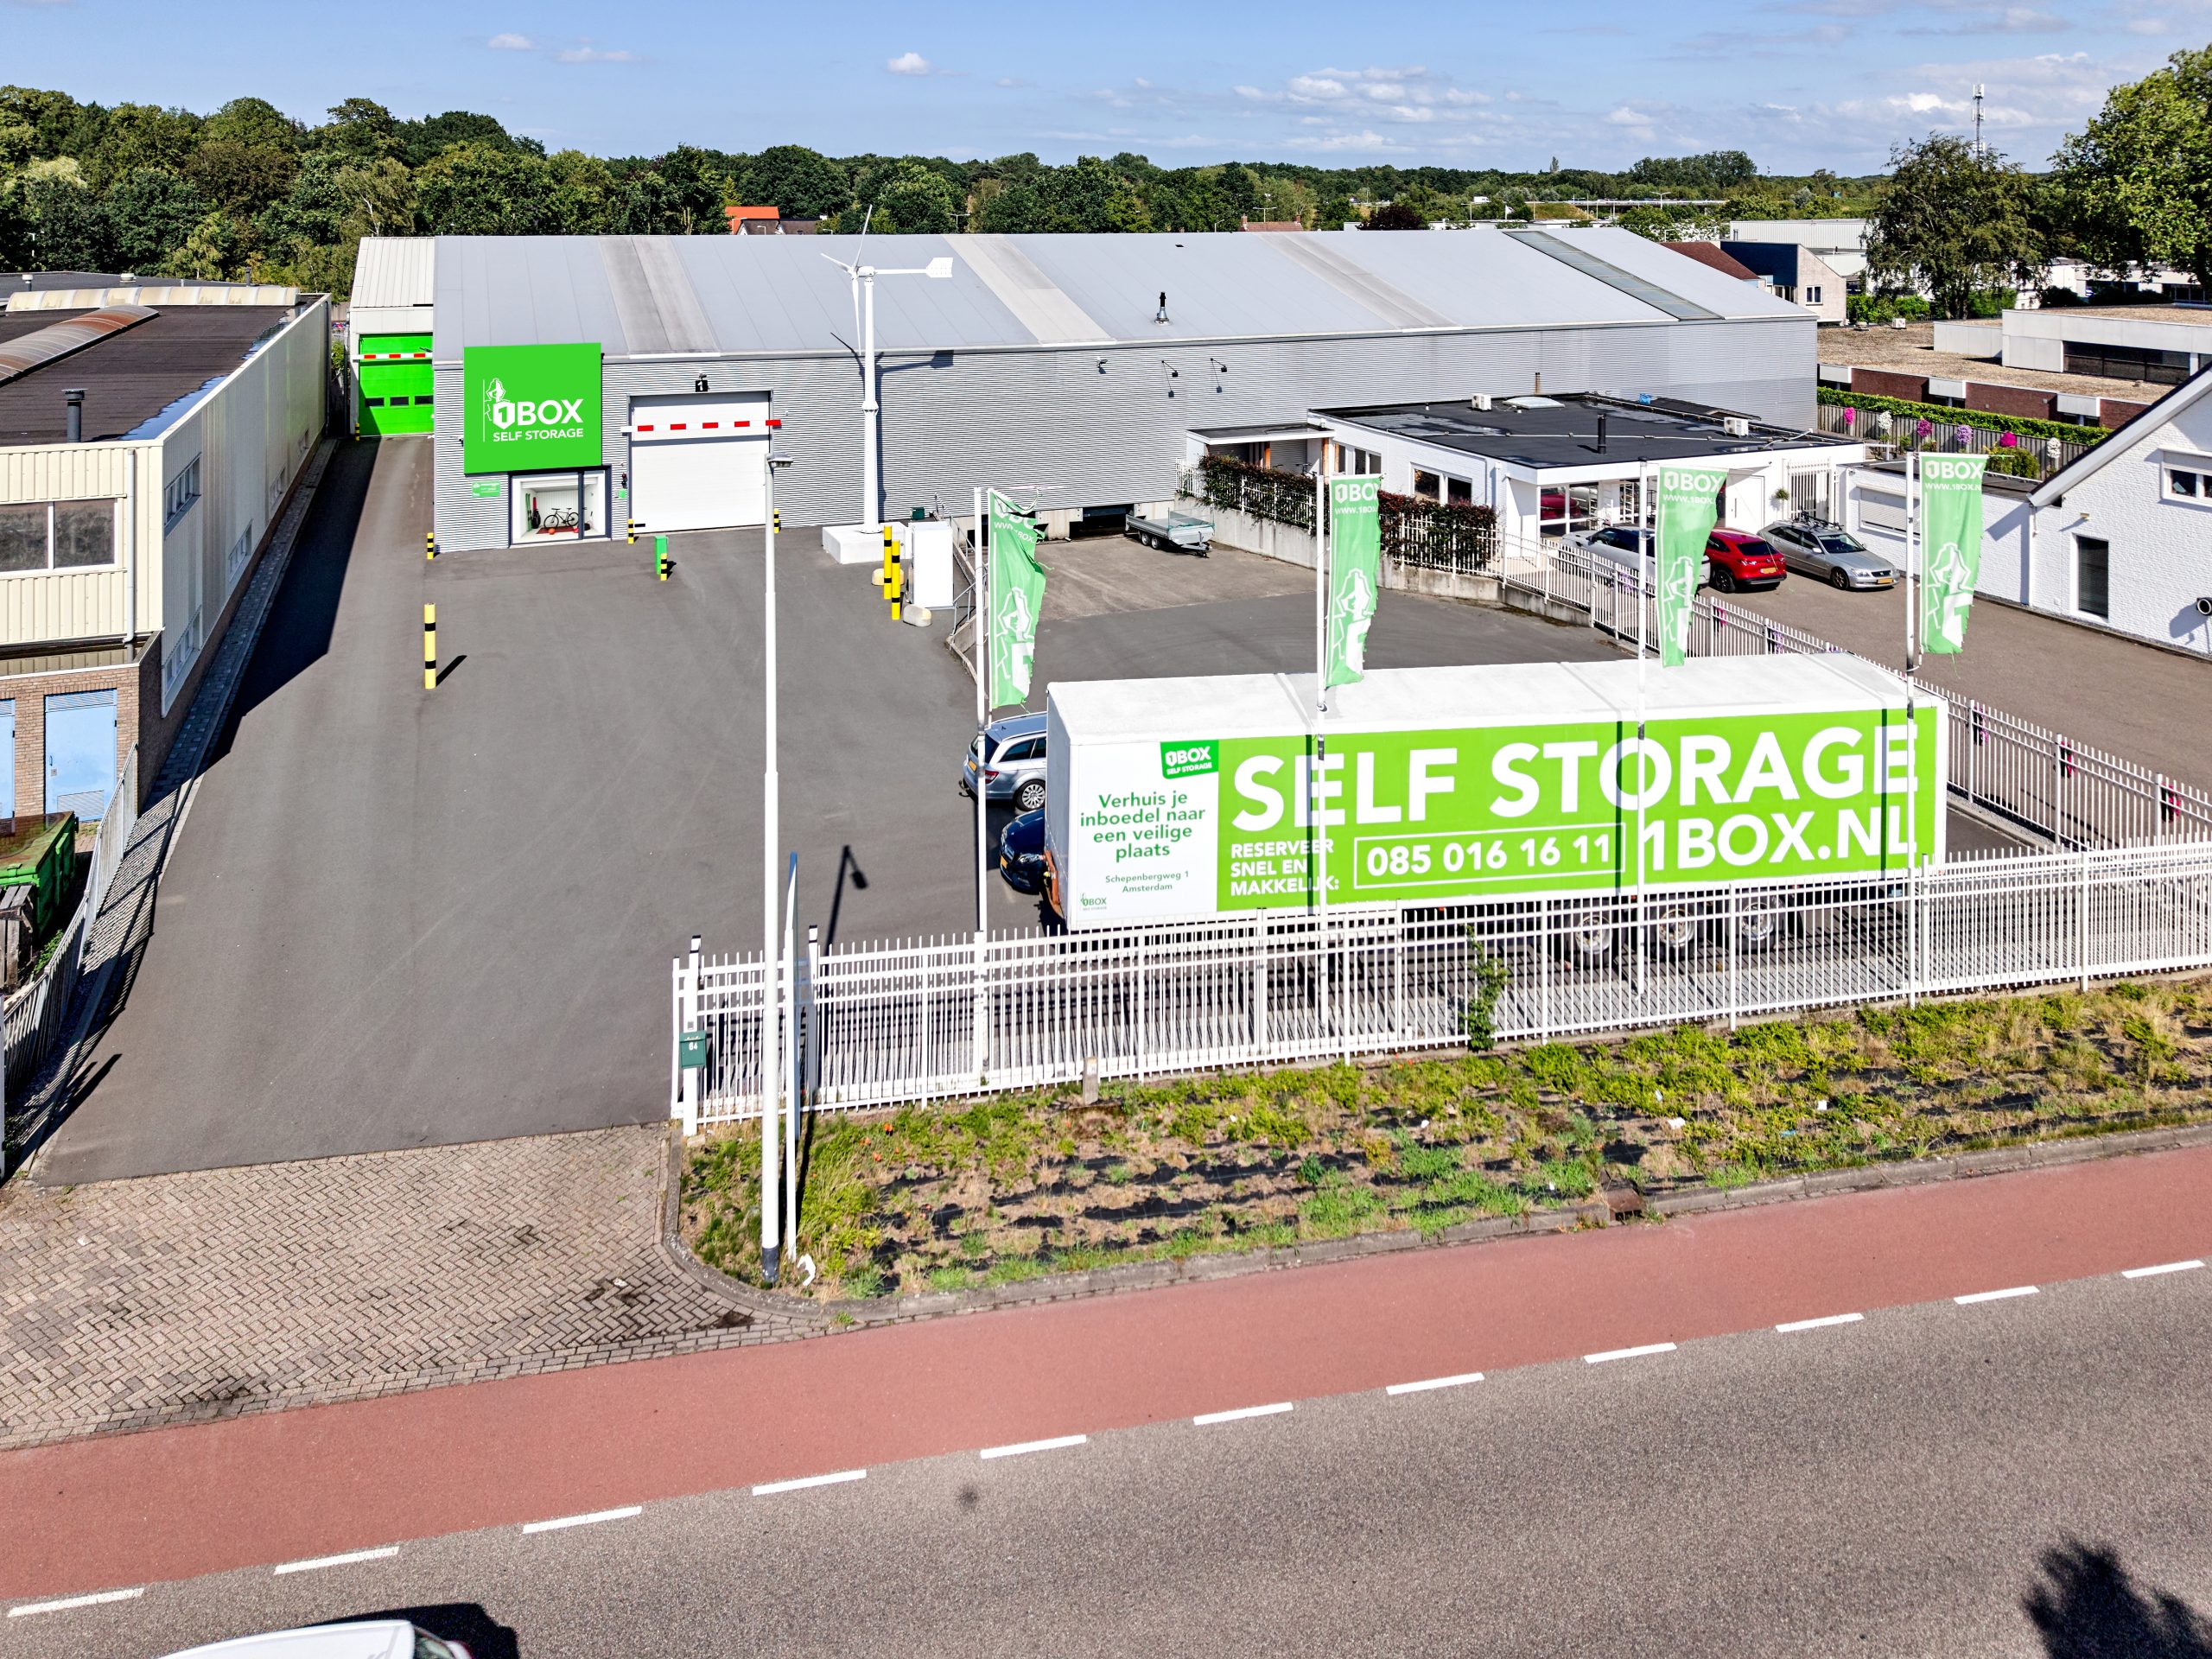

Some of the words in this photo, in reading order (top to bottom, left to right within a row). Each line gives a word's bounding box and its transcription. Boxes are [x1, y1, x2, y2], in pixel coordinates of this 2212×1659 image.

[697, 380, 703, 391] 1
[493, 398, 584, 429] 1BOX
[493, 431, 522, 442] SELF
[525, 429, 584, 440] STORAGE
[1925, 460, 1983, 480] 1BOX
[1664, 471, 1723, 492] 1BOX
[1165, 746, 1211, 767] 1BOX
[1182, 761, 1212, 772] STORAGE
[1231, 748, 1458, 831] SELF
[1490, 727, 1918, 818] STORAGE
[1098, 791, 1166, 809] Verhuis
[1171, 790, 1188, 809] je
[1080, 807, 1160, 827] inboedel
[1166, 809, 1206, 822] naar
[1093, 830, 1126, 843] een
[1133, 823, 1192, 842] veilige
[1643, 805, 1917, 870] 1BOX.NL
[1116, 842, 1171, 863] plaats
[1231, 838, 1334, 859] RESERVEER
[1367, 844, 1431, 876] 085
[1443, 841, 1507, 872] 016
[1520, 836, 1560, 867] 16
[1573, 834, 1609, 863] 11
[1105, 872, 1181, 883] Schepenbergweg
[1230, 861, 1277, 878] SNEL
[1282, 858, 1308, 874] EN
[1122, 883, 1173, 893] Amsterdam
[1230, 875, 1339, 896] MAKKELIJK:
